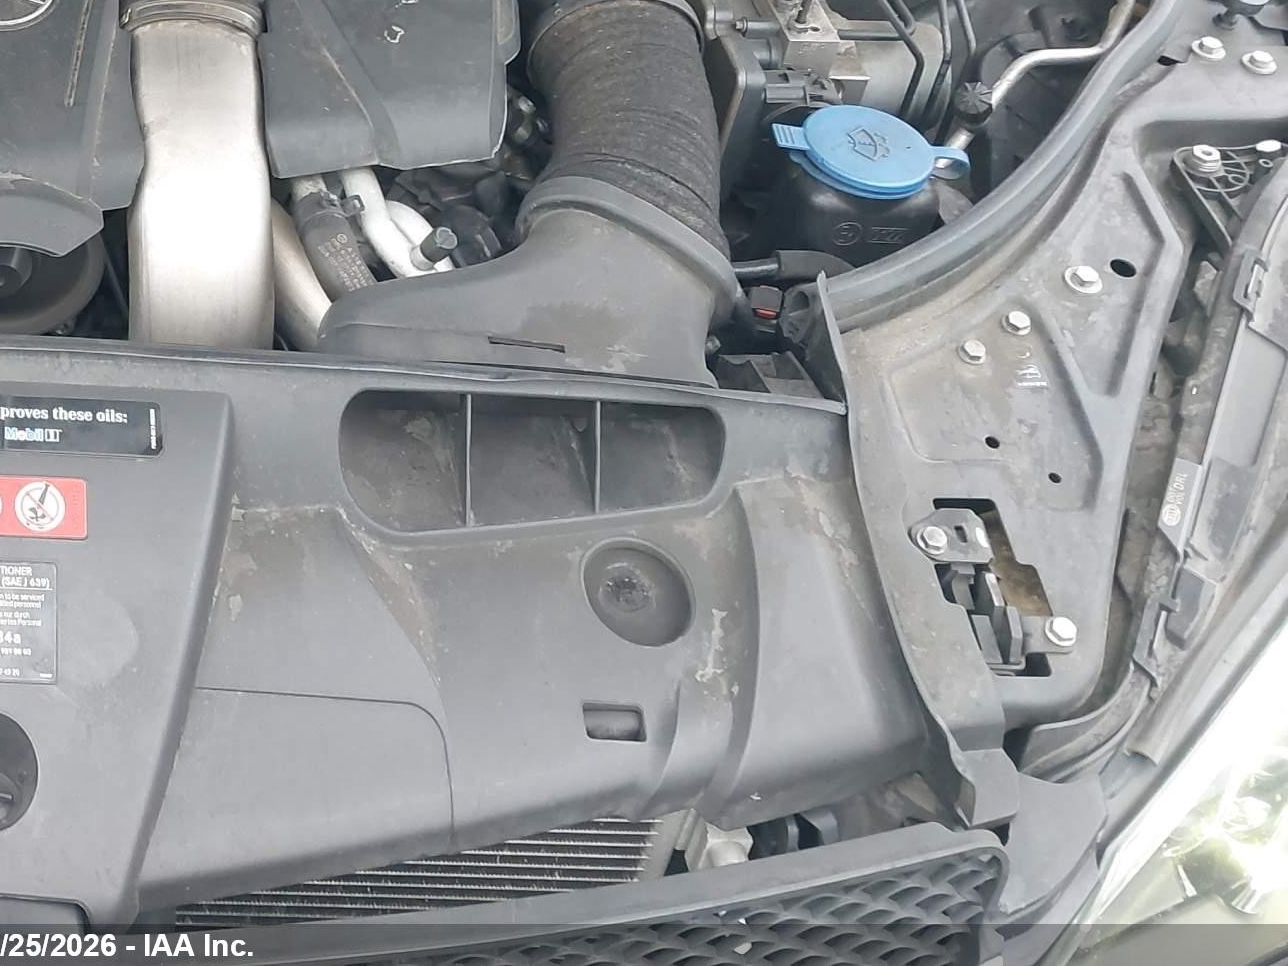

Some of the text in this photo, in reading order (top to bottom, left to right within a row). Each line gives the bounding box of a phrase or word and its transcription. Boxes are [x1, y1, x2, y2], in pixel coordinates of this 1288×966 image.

[52, 407, 93, 422] these
[96, 409, 128, 424] oils:
[4, 426, 44, 442] Mobil
